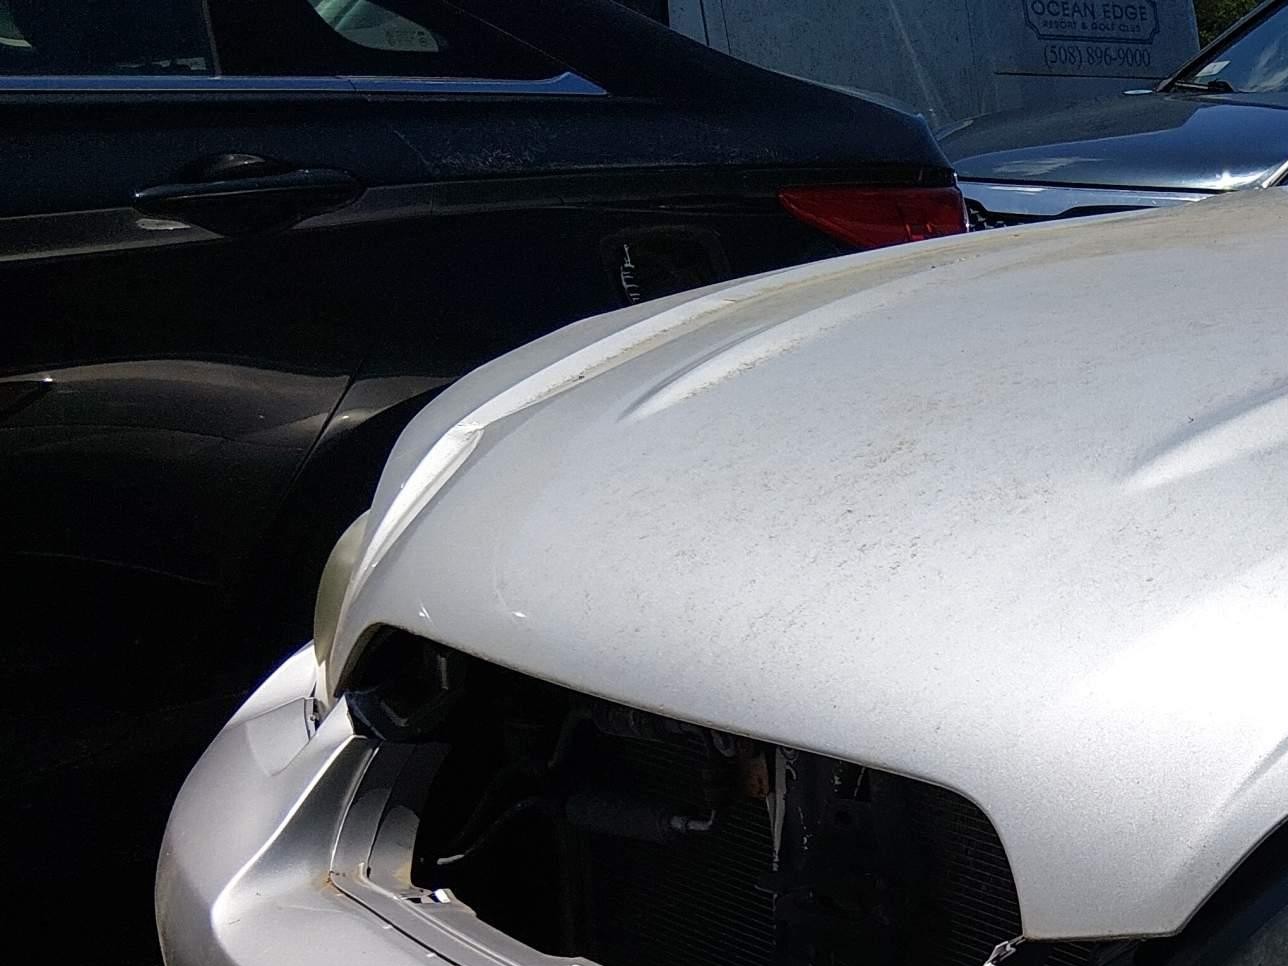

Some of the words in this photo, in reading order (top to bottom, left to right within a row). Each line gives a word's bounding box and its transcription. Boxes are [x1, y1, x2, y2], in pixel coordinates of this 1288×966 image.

[1031, 0, 1096, 20] OCEAN
[1102, 4, 1148, 21] EDGE
[1044, 45, 1082, 69] (508)
[1087, 48, 1150, 67] 896-9000
